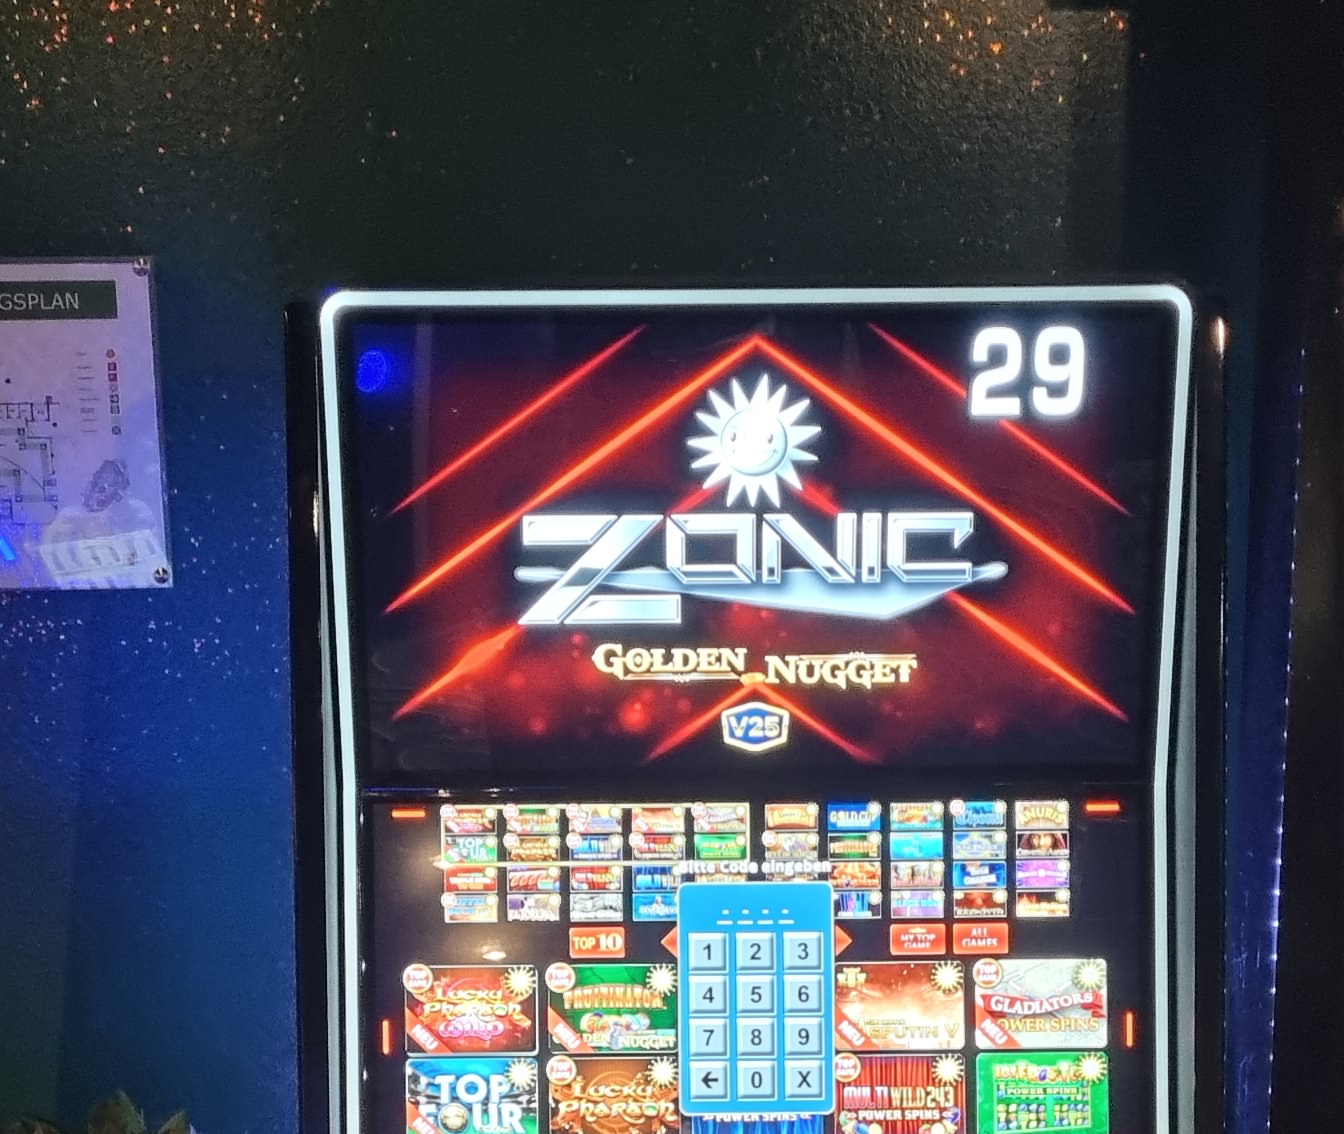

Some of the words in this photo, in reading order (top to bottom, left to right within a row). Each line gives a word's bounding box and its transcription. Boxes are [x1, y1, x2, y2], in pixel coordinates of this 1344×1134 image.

[969, 325, 1087, 418] 29
[518, 510, 976, 626] ZONIC
[592, 642, 748, 678] GOLDEN
[765, 653, 917, 688] NUGGET
[728, 715, 782, 740] V25
[678, 860, 715, 874] Bitte
[719, 859, 758, 874] Code
[761, 859, 832, 878] eingeben
[572, 937, 597, 951] TOP
[597, 932, 623, 951] 10
[917, 933, 936, 942] TOP
[971, 928, 987, 937] ALL
[703, 943, 712, 960] 1
[749, 943, 761, 960] 2
[797, 943, 809, 960] 3
[962, 938, 998, 947] GAMES
[702, 987, 714, 1004] 4
[750, 986, 762, 1003] 5
[798, 986, 809, 1003] 6
[990, 992, 1094, 1014] GLADIATORS
[838, 1020, 865, 1046] NEU
[868, 1026, 939, 1039] SPUTIN
[981, 1018, 1008, 1045] NEU
[997, 1018, 1047, 1032] OWER
[1050, 1018, 1099, 1032] SPINS
[411, 1023, 438, 1050] NEU
[618, 1035, 676, 1050] NUGGET
[702, 1029, 714, 1046] 7
[750, 1029, 762, 1046] 8
[798, 1028, 810, 1045] 9
[751, 1071, 762, 1088] 0
[797, 1070, 811, 1088] X
[434, 1073, 510, 1105] TOP
[843, 1086, 889, 1109] MULTI
[890, 1086, 926, 1108] WILD
[926, 1086, 954, 1108] 243
[762, 1114, 798, 1122] SPINS
[858, 1110, 903, 1120] POWER
[904, 1109, 940, 1120] SPINS
